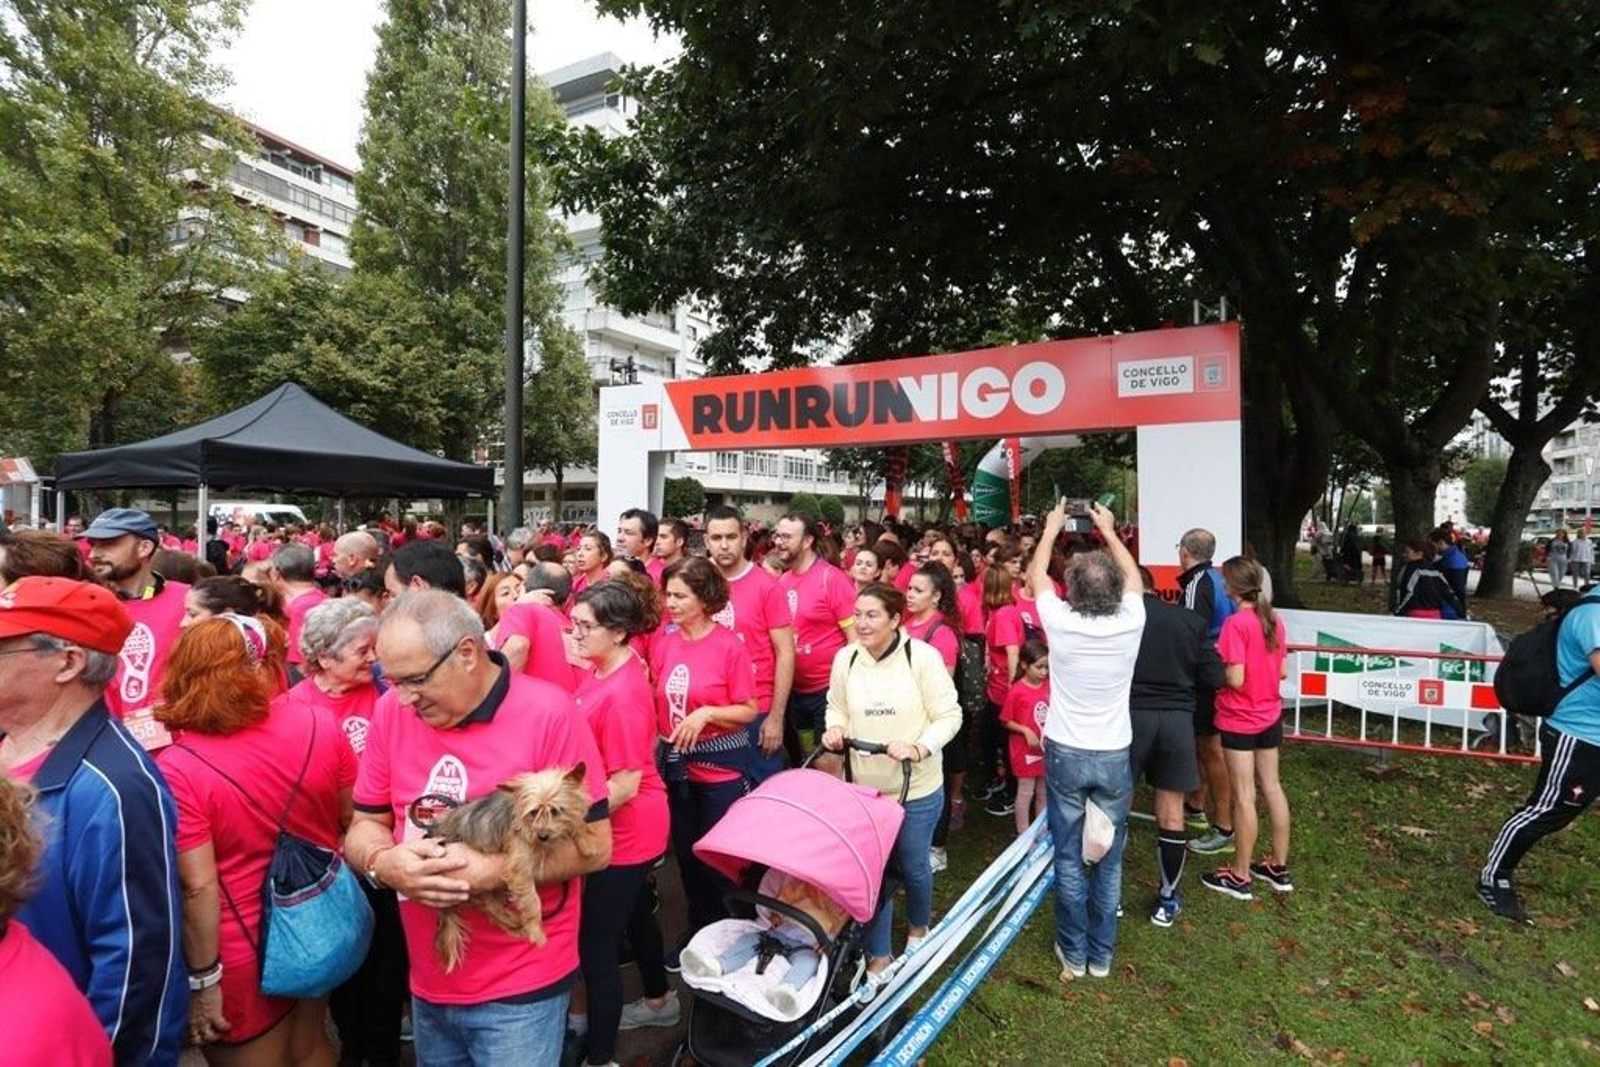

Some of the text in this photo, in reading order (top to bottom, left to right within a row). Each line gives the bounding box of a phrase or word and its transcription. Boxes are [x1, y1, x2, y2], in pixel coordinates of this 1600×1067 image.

[1123, 364, 1187, 378] CONCELLO
[1130, 377, 1180, 389] DE VIGO
[1362, 680, 1412, 690] CONCELLO
[1384, 690, 1406, 698] VIGO
